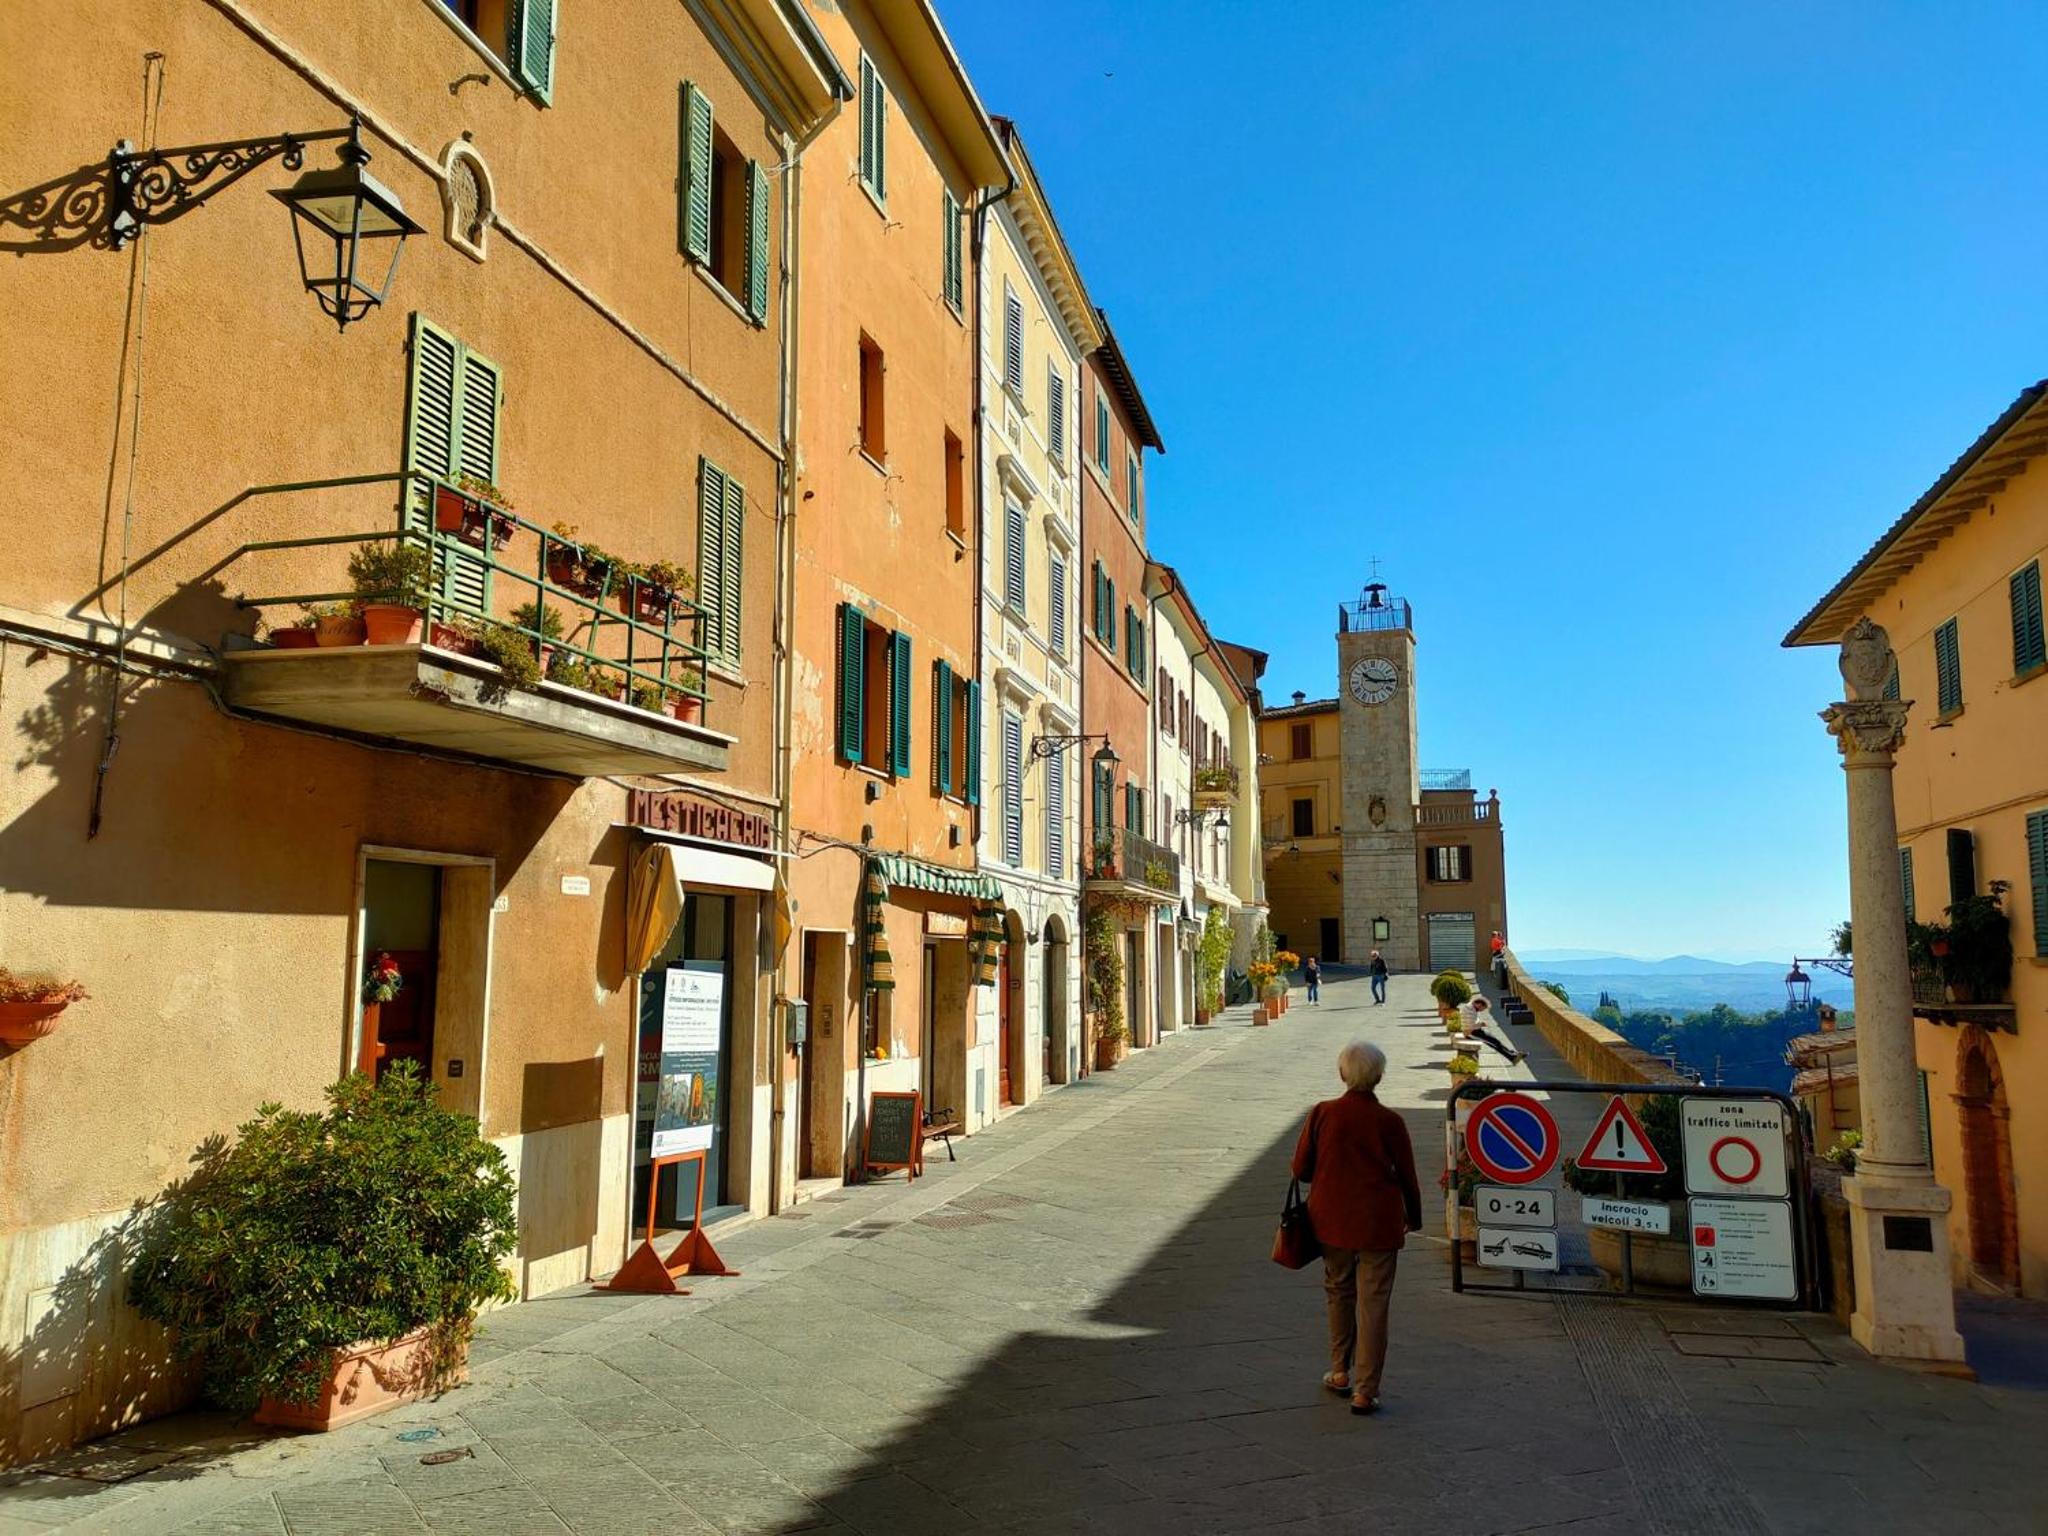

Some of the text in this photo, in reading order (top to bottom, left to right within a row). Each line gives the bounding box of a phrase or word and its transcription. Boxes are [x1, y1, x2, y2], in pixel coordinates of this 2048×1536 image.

[628, 788, 772, 849] MESTICHERIA
[1720, 1106, 1744, 1114] zona
[1687, 1117, 1779, 1130] traffico limitato
[1591, 1214, 1630, 1227] veicoli
